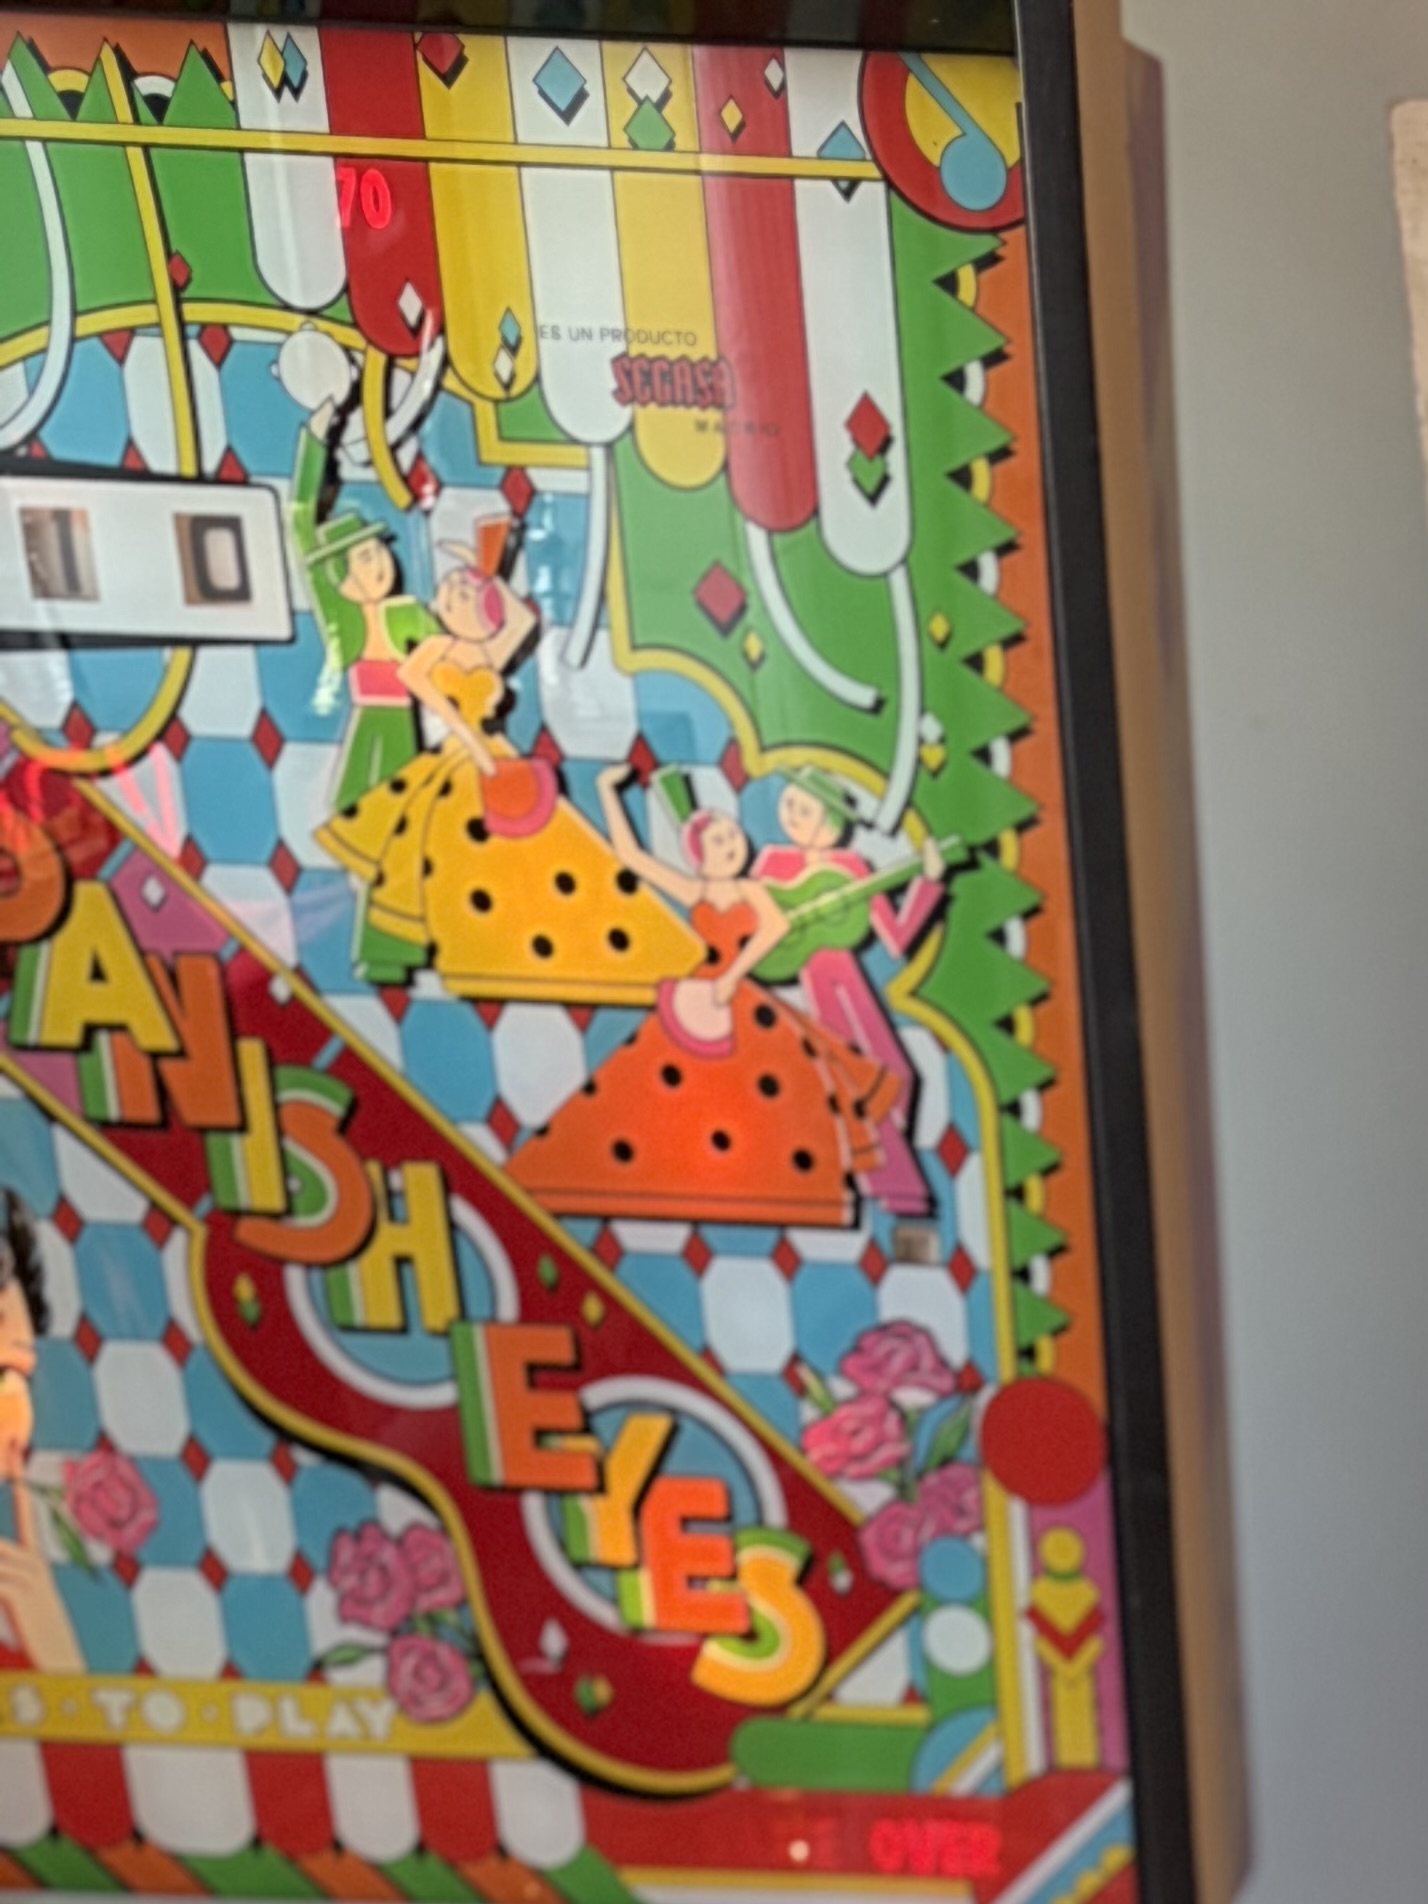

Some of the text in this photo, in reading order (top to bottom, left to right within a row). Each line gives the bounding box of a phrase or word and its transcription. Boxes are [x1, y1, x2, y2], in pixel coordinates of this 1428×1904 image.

[336, 169, 392, 229] 70
[600, 327, 697, 347] PRODUCTO
[448, 1318, 826, 1708] EYES
